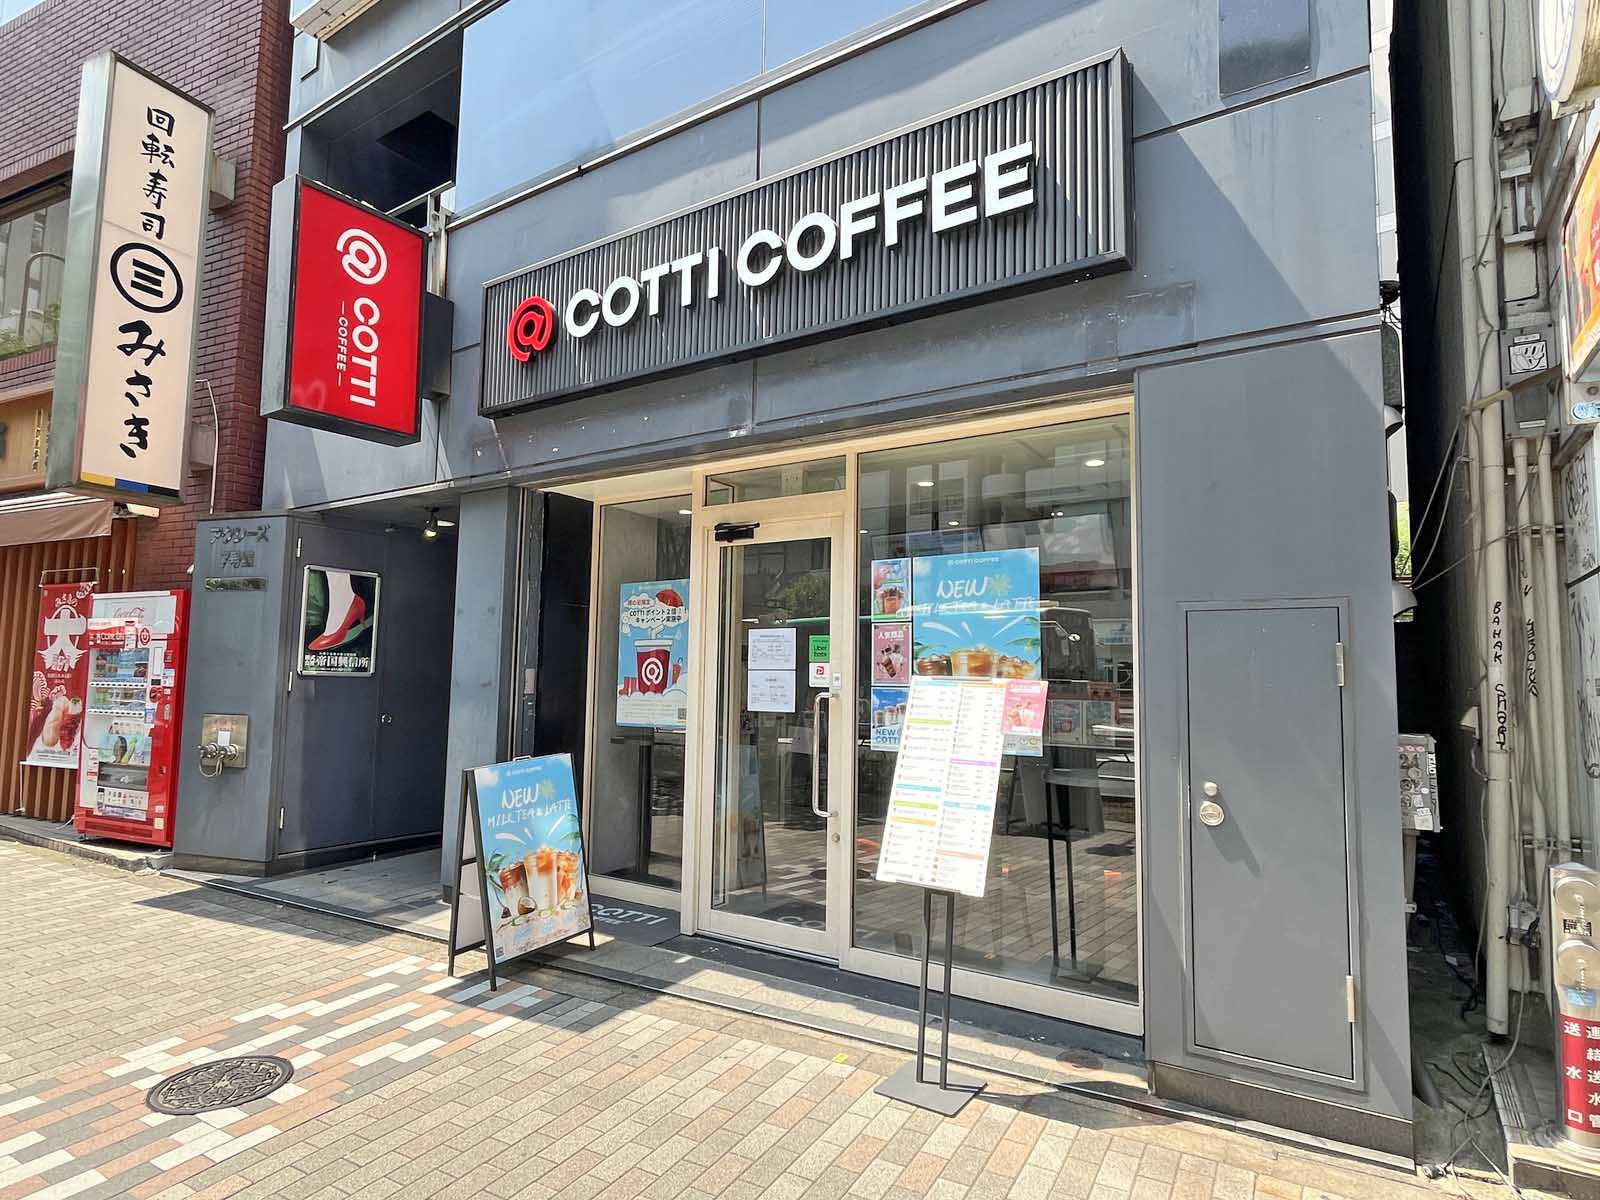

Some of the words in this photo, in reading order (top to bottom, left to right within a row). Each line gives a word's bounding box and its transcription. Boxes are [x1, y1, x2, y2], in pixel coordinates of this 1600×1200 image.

[140, 106, 175, 240] 回転寿司
[565, 246, 719, 339] COTTI
[737, 141, 1036, 289] COFFEE
[117, 320, 166, 458] みさき
[336, 316, 349, 371] COFFEE
[349, 297, 380, 407] COTTI
[936, 576, 989, 599] NEW
[501, 783, 540, 809] NEW
[1564, 1021, 1583, 1124] 送水口
